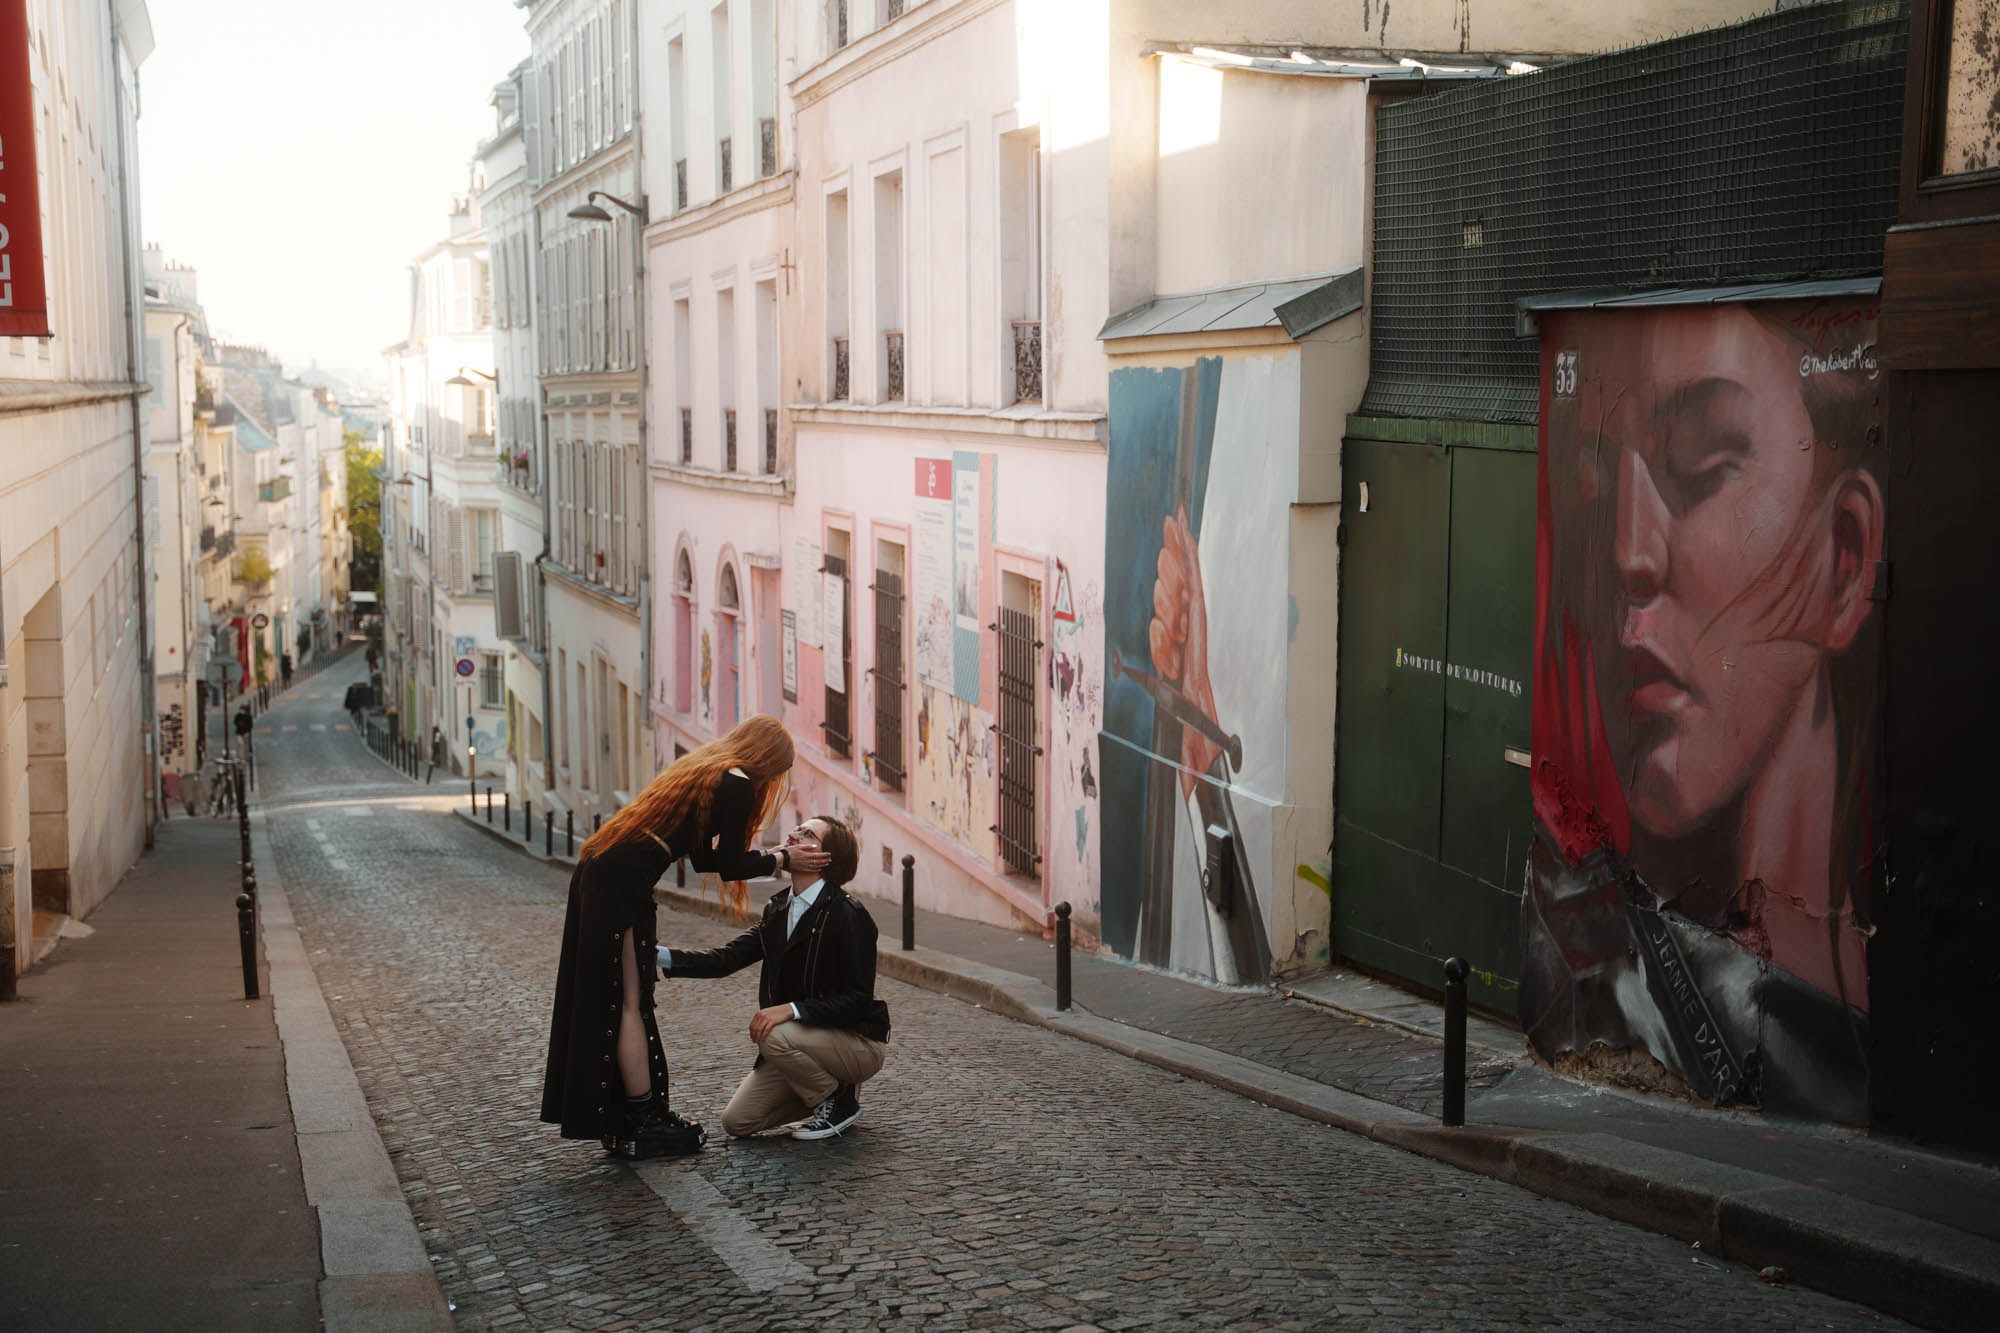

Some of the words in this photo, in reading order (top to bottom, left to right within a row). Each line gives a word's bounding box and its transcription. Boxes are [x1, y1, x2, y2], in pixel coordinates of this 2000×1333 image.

[1556, 351, 1577, 394] 33
[1403, 652, 1442, 674] SORTIE
[1446, 663, 1461, 679] DE
[1464, 667, 1523, 695] VOITURES
[1652, 932, 1699, 1018] JEANNE
